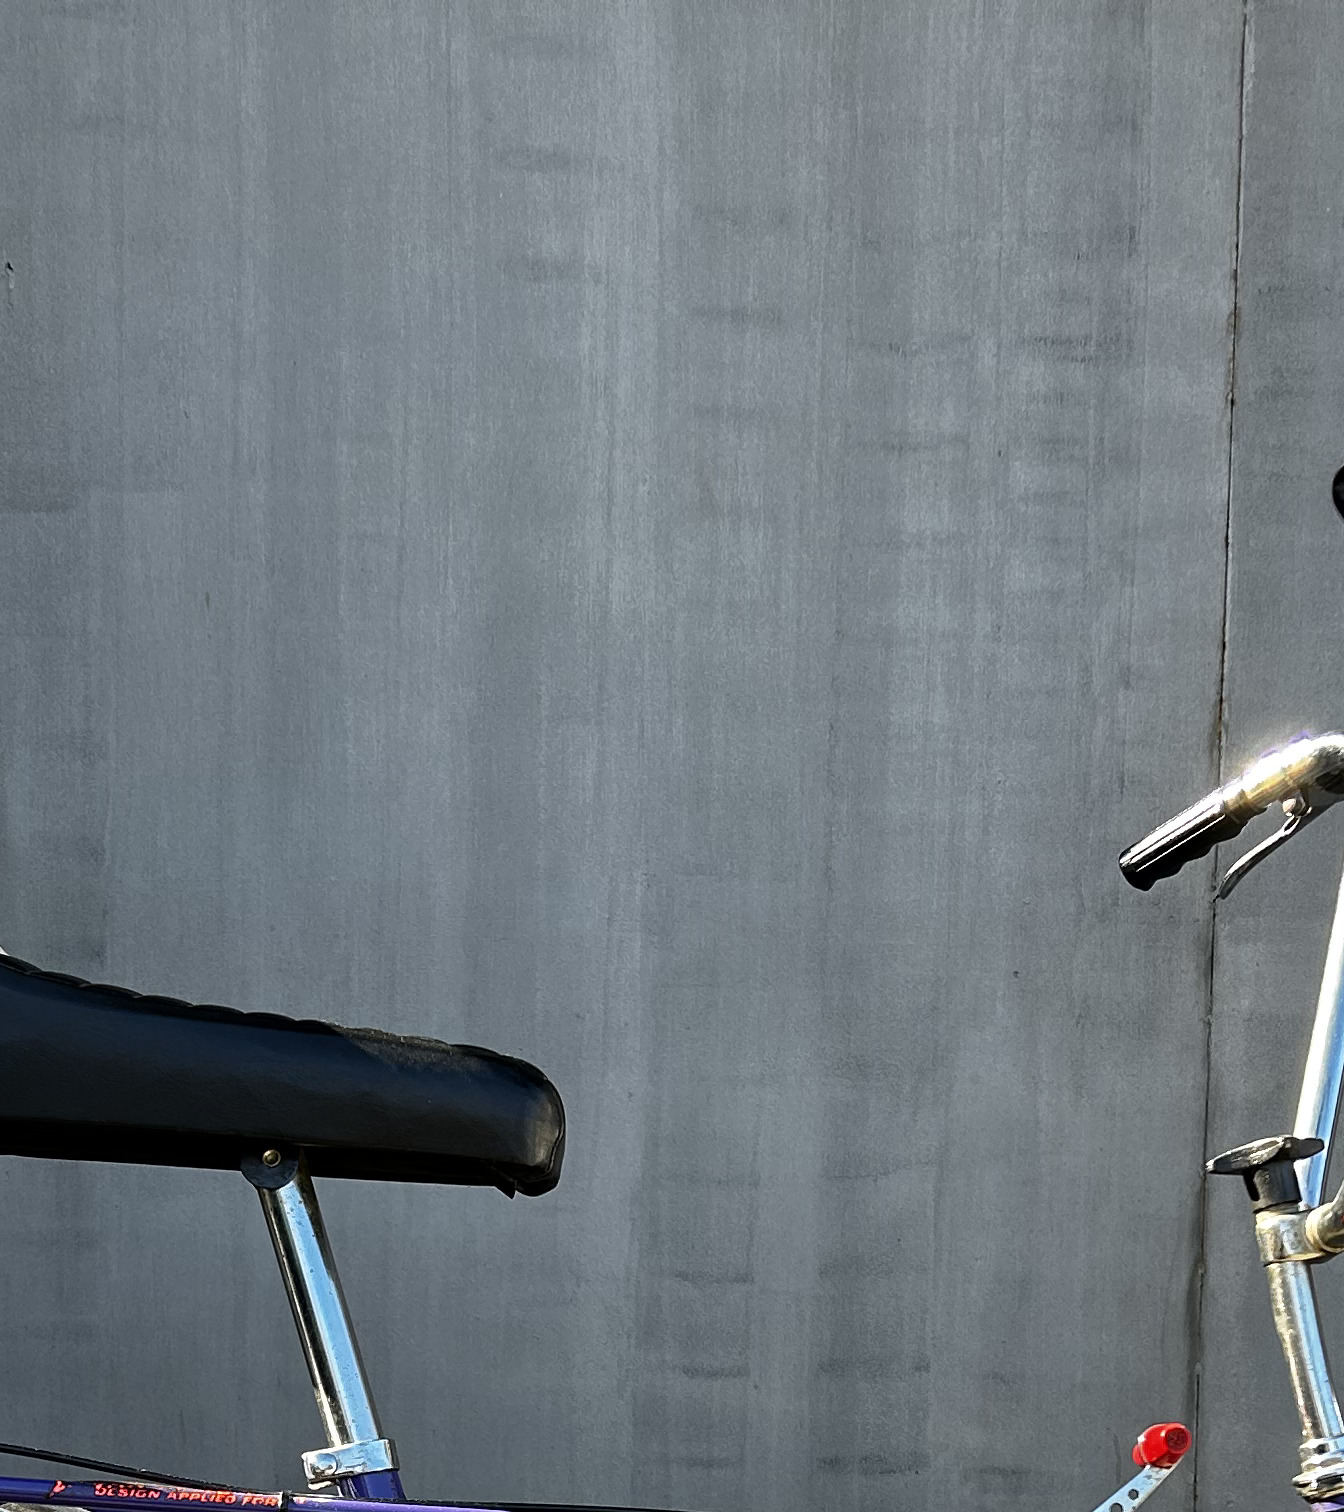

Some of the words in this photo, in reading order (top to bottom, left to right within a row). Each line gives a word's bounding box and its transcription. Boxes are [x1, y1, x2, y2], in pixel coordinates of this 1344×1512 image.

[94, 1486, 161, 1499] DESIGN
[166, 1490, 237, 1504] APPLIED
[241, 1495, 278, 1507] FOR
